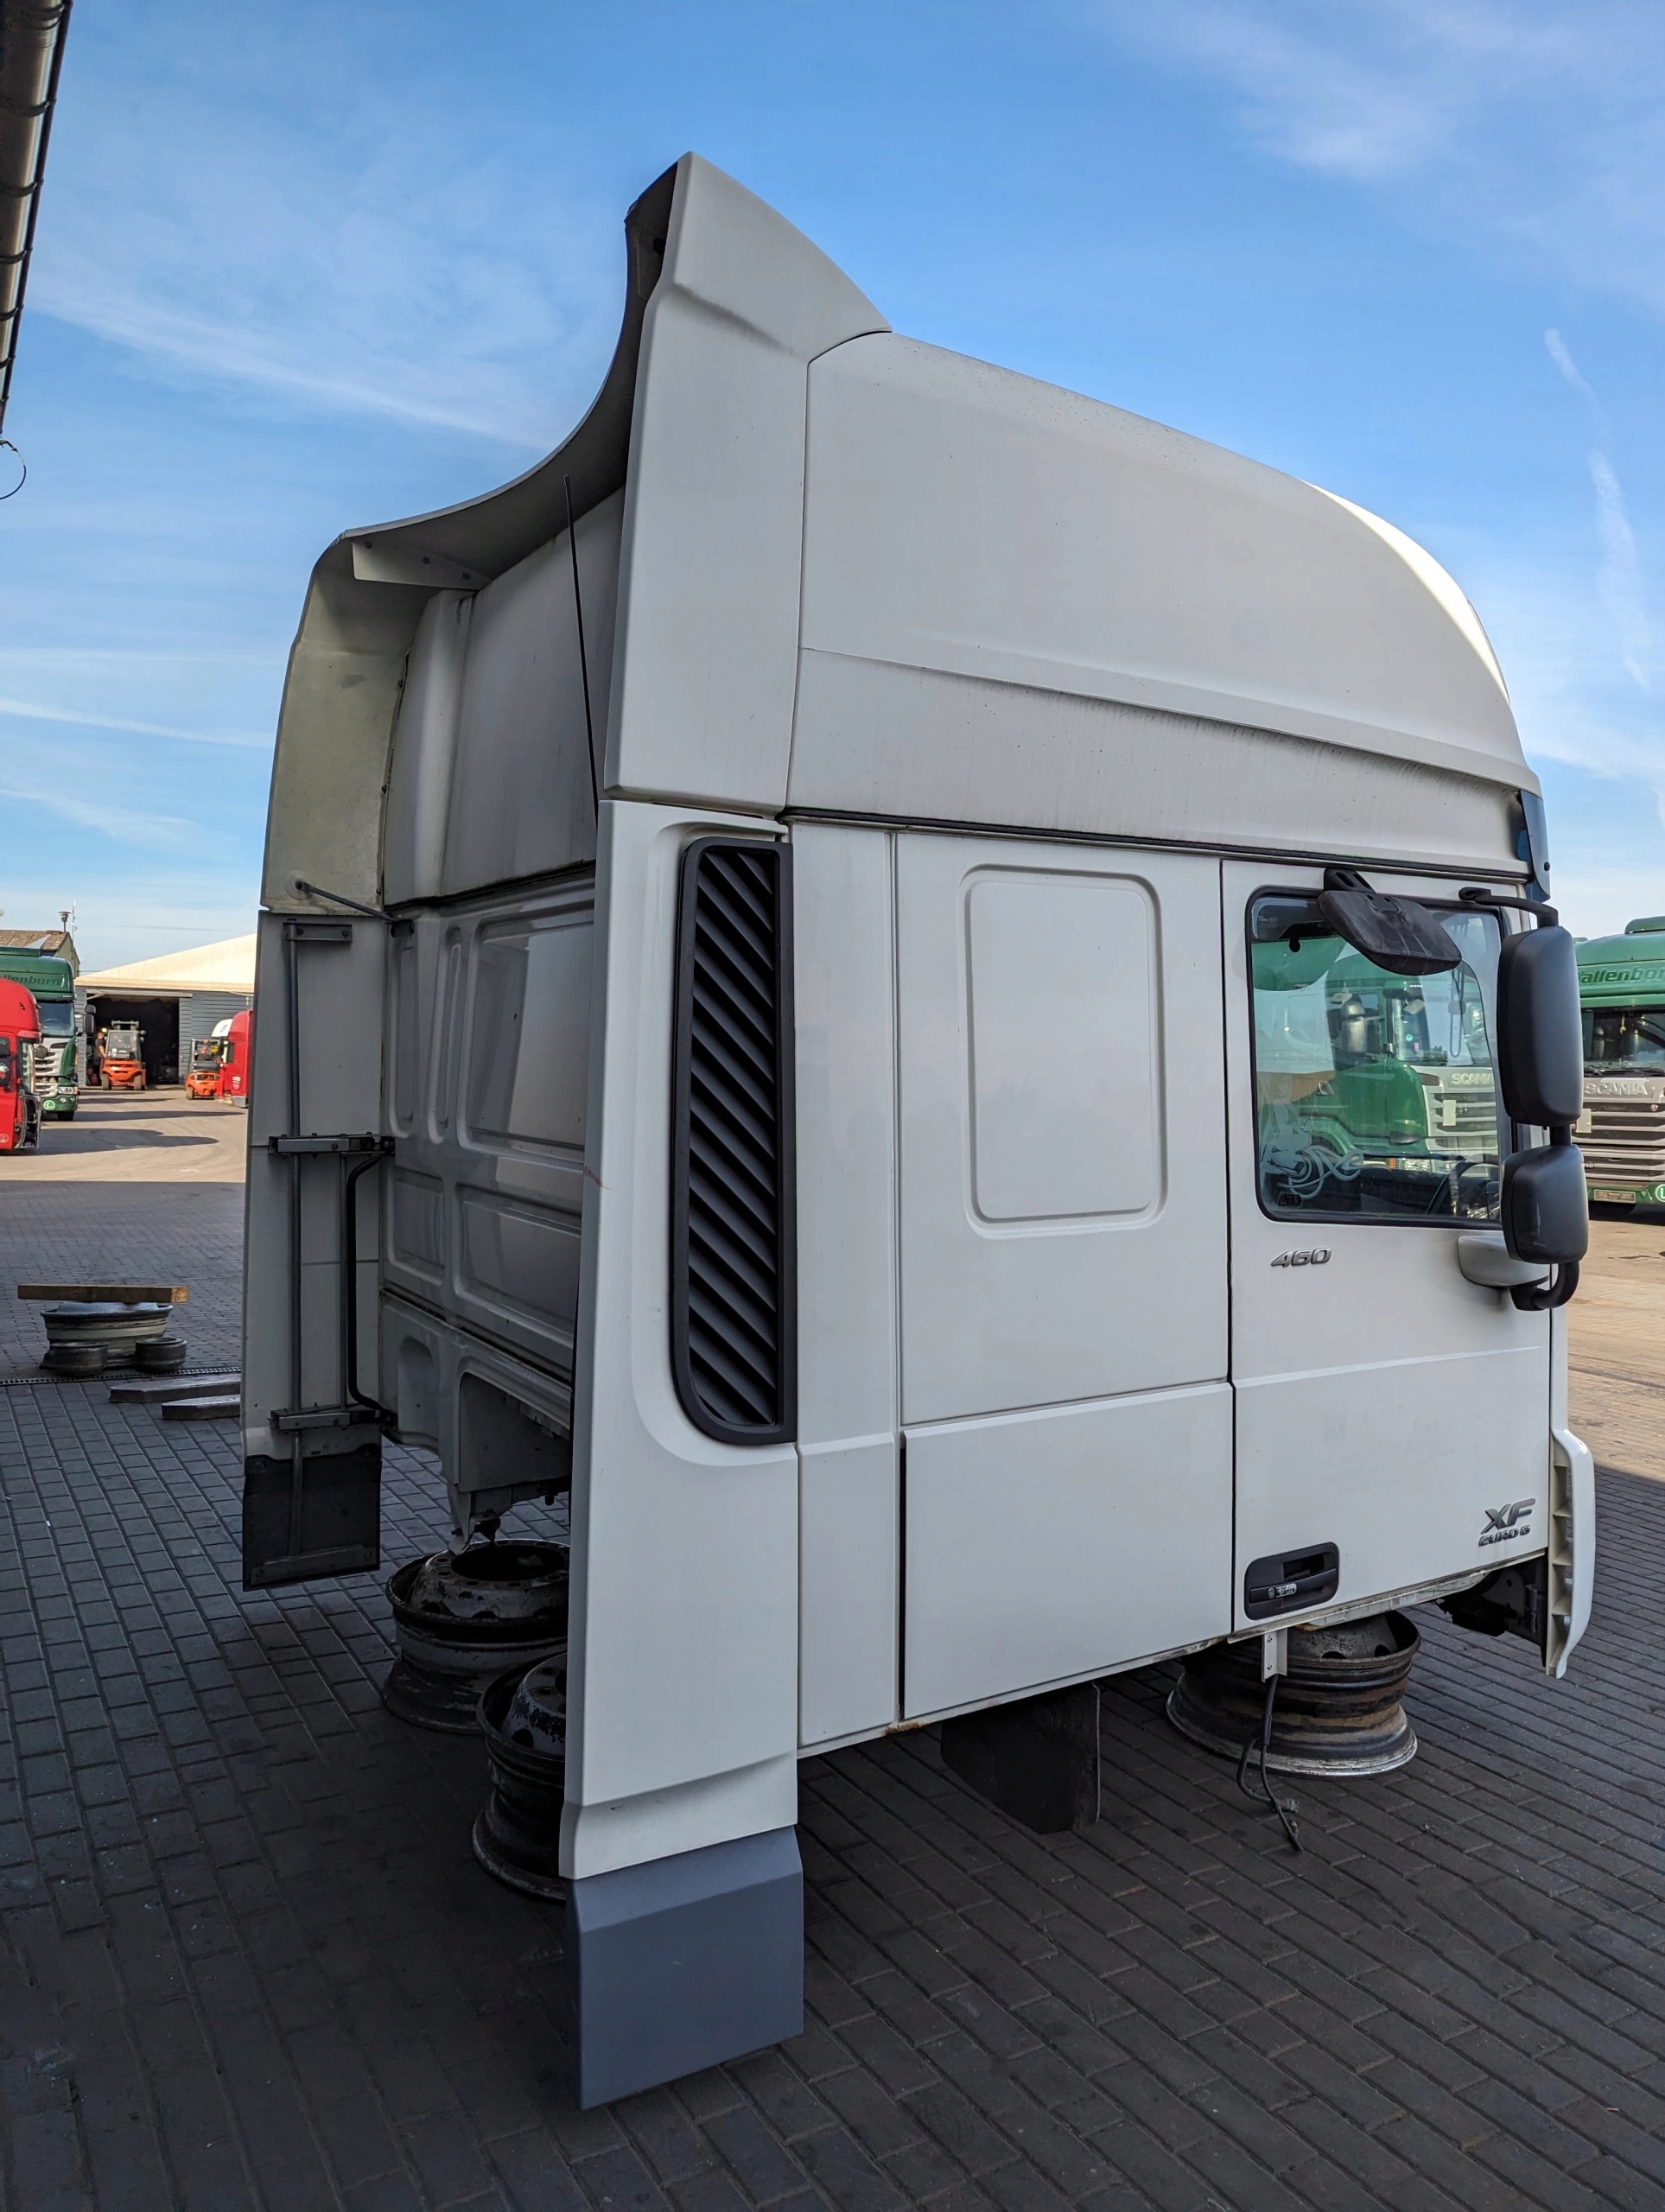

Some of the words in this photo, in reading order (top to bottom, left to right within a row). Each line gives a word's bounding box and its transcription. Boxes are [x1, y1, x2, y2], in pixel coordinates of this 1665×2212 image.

[1579, 966, 1665, 983] allenbor
[1584, 1082, 1649, 1096] SCANIA
[1270, 1248, 1332, 1268] 460
[1480, 1497, 1536, 1535] XF
